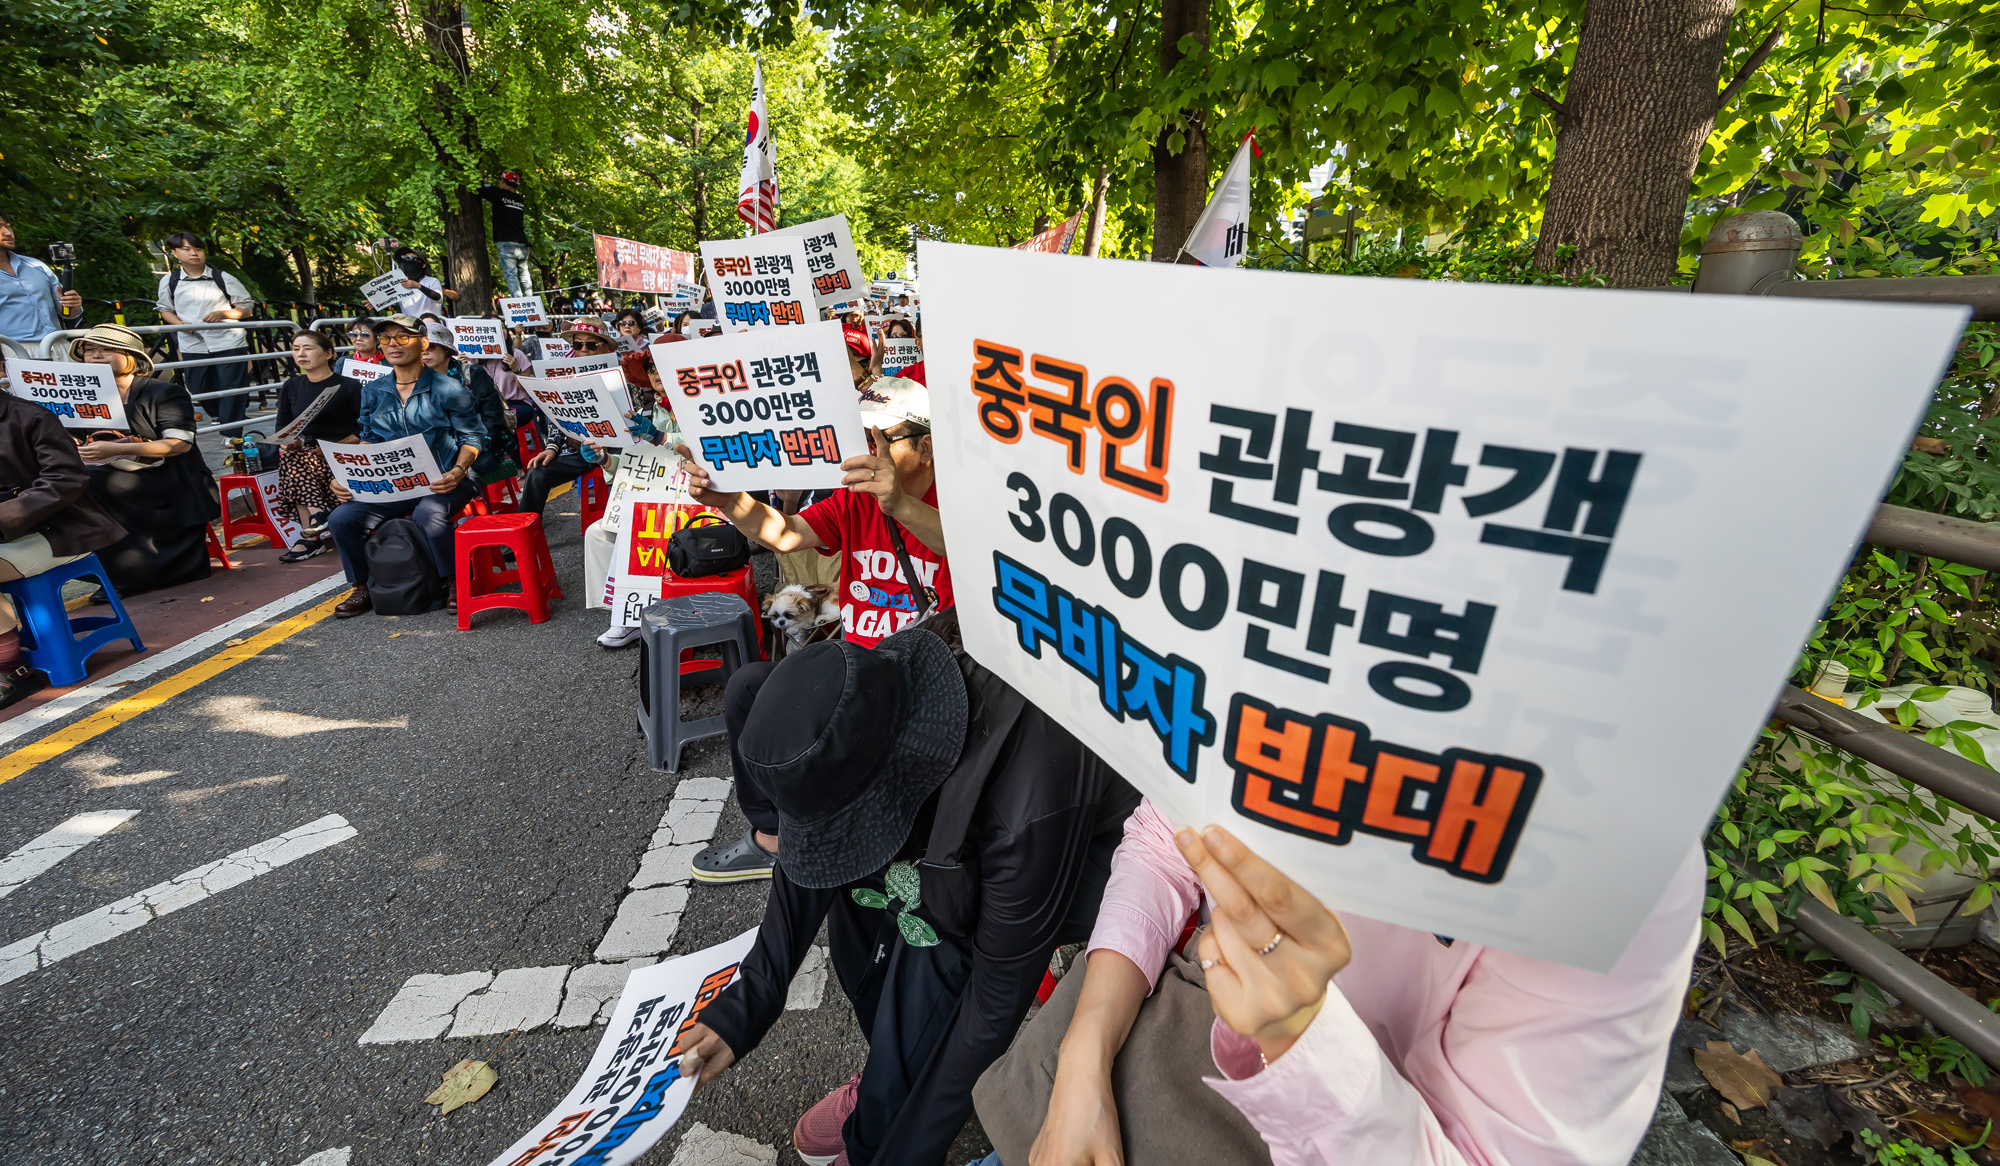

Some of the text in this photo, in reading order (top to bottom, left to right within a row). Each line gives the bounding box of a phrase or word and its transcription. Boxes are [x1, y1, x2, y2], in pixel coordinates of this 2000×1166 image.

[615, 239, 639, 265] 중국인
[713, 255, 794, 277] 중국인 관광객
[724, 277, 791, 297] 3000만명
[814, 269, 851, 295] 반대
[724, 300, 805, 325] 무비자 반대
[454, 325, 497, 335] 중국인 관광객
[459, 334, 495, 343] 3000만명
[458, 344, 502, 354] 무비자 반대
[883, 355, 917, 365] 000만명
[21, 370, 101, 388] 중국인 관광객
[352, 368, 376, 379] 중국인
[675, 352, 822, 398] 중국인 관광객
[30, 387, 98, 402] 3000만명
[533, 388, 599, 406] 중국인 관광객
[74, 403, 112, 420] 반대
[549, 405, 600, 419] 3000만명
[699, 390, 816, 426] 3000만명
[584, 420, 617, 438] 반대
[332, 447, 416, 466] 중국인 관광객
[700, 425, 843, 471] 무비자 반대
[345, 461, 414, 478] 3000만명
[971, 338, 1644, 596] 중국인 관광객
[346, 471, 431, 494] 무비자 반대
[1006, 471, 1498, 713] 3000만명
[992, 549, 1545, 885] 무비자 반대
[579, 995, 667, 1106] 관광객
